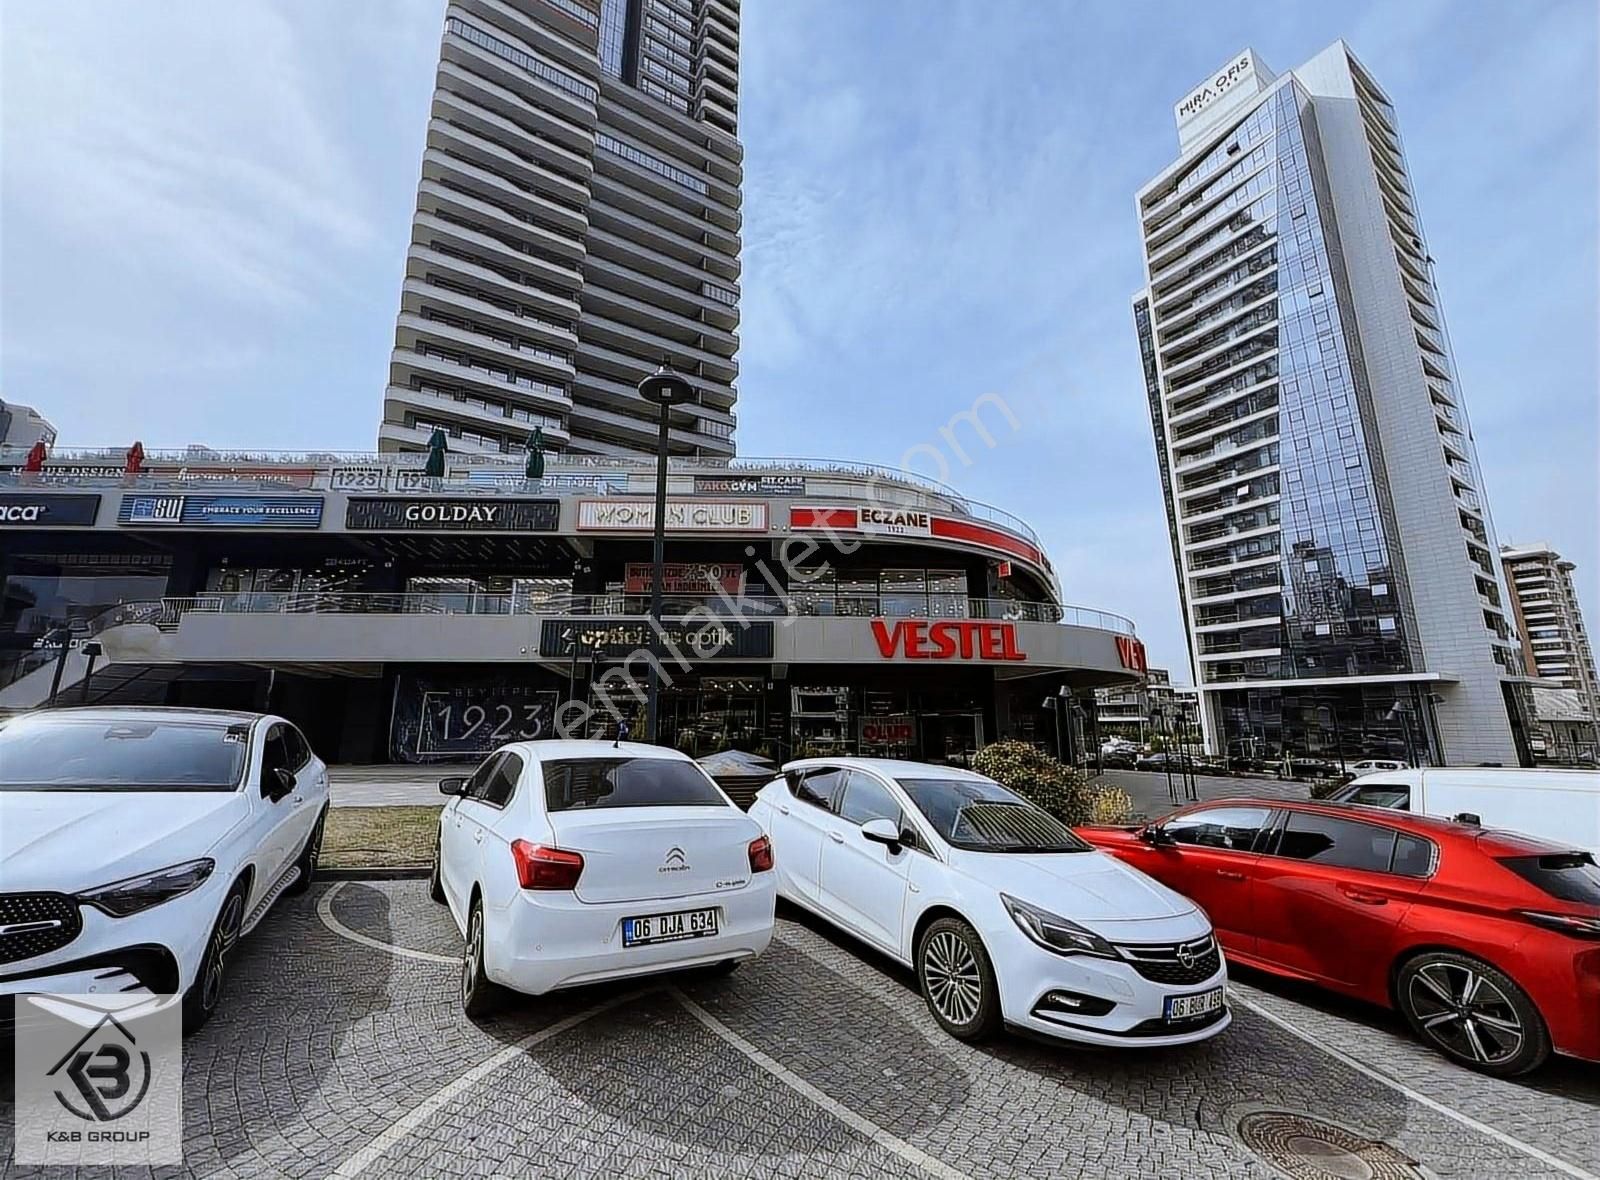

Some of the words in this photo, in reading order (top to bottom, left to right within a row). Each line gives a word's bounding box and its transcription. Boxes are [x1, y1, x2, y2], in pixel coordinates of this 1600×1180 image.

[1180, 88, 1212, 116] MIRA
[242, 506, 264, 514] YOUR
[405, 505, 498, 522] GOLDAY
[594, 506, 685, 524] WOMN
[693, 507, 753, 525] CLUB
[861, 508, 928, 528] ECZANE
[685, 627, 735, 650] optik
[869, 618, 1028, 662] VESTEL
[438, 704, 543, 740] 1923
[634, 919, 651, 938] 06
[660, 914, 685, 934] DJA
[690, 911, 714, 930] 634
[1172, 999, 1185, 1017] 06
